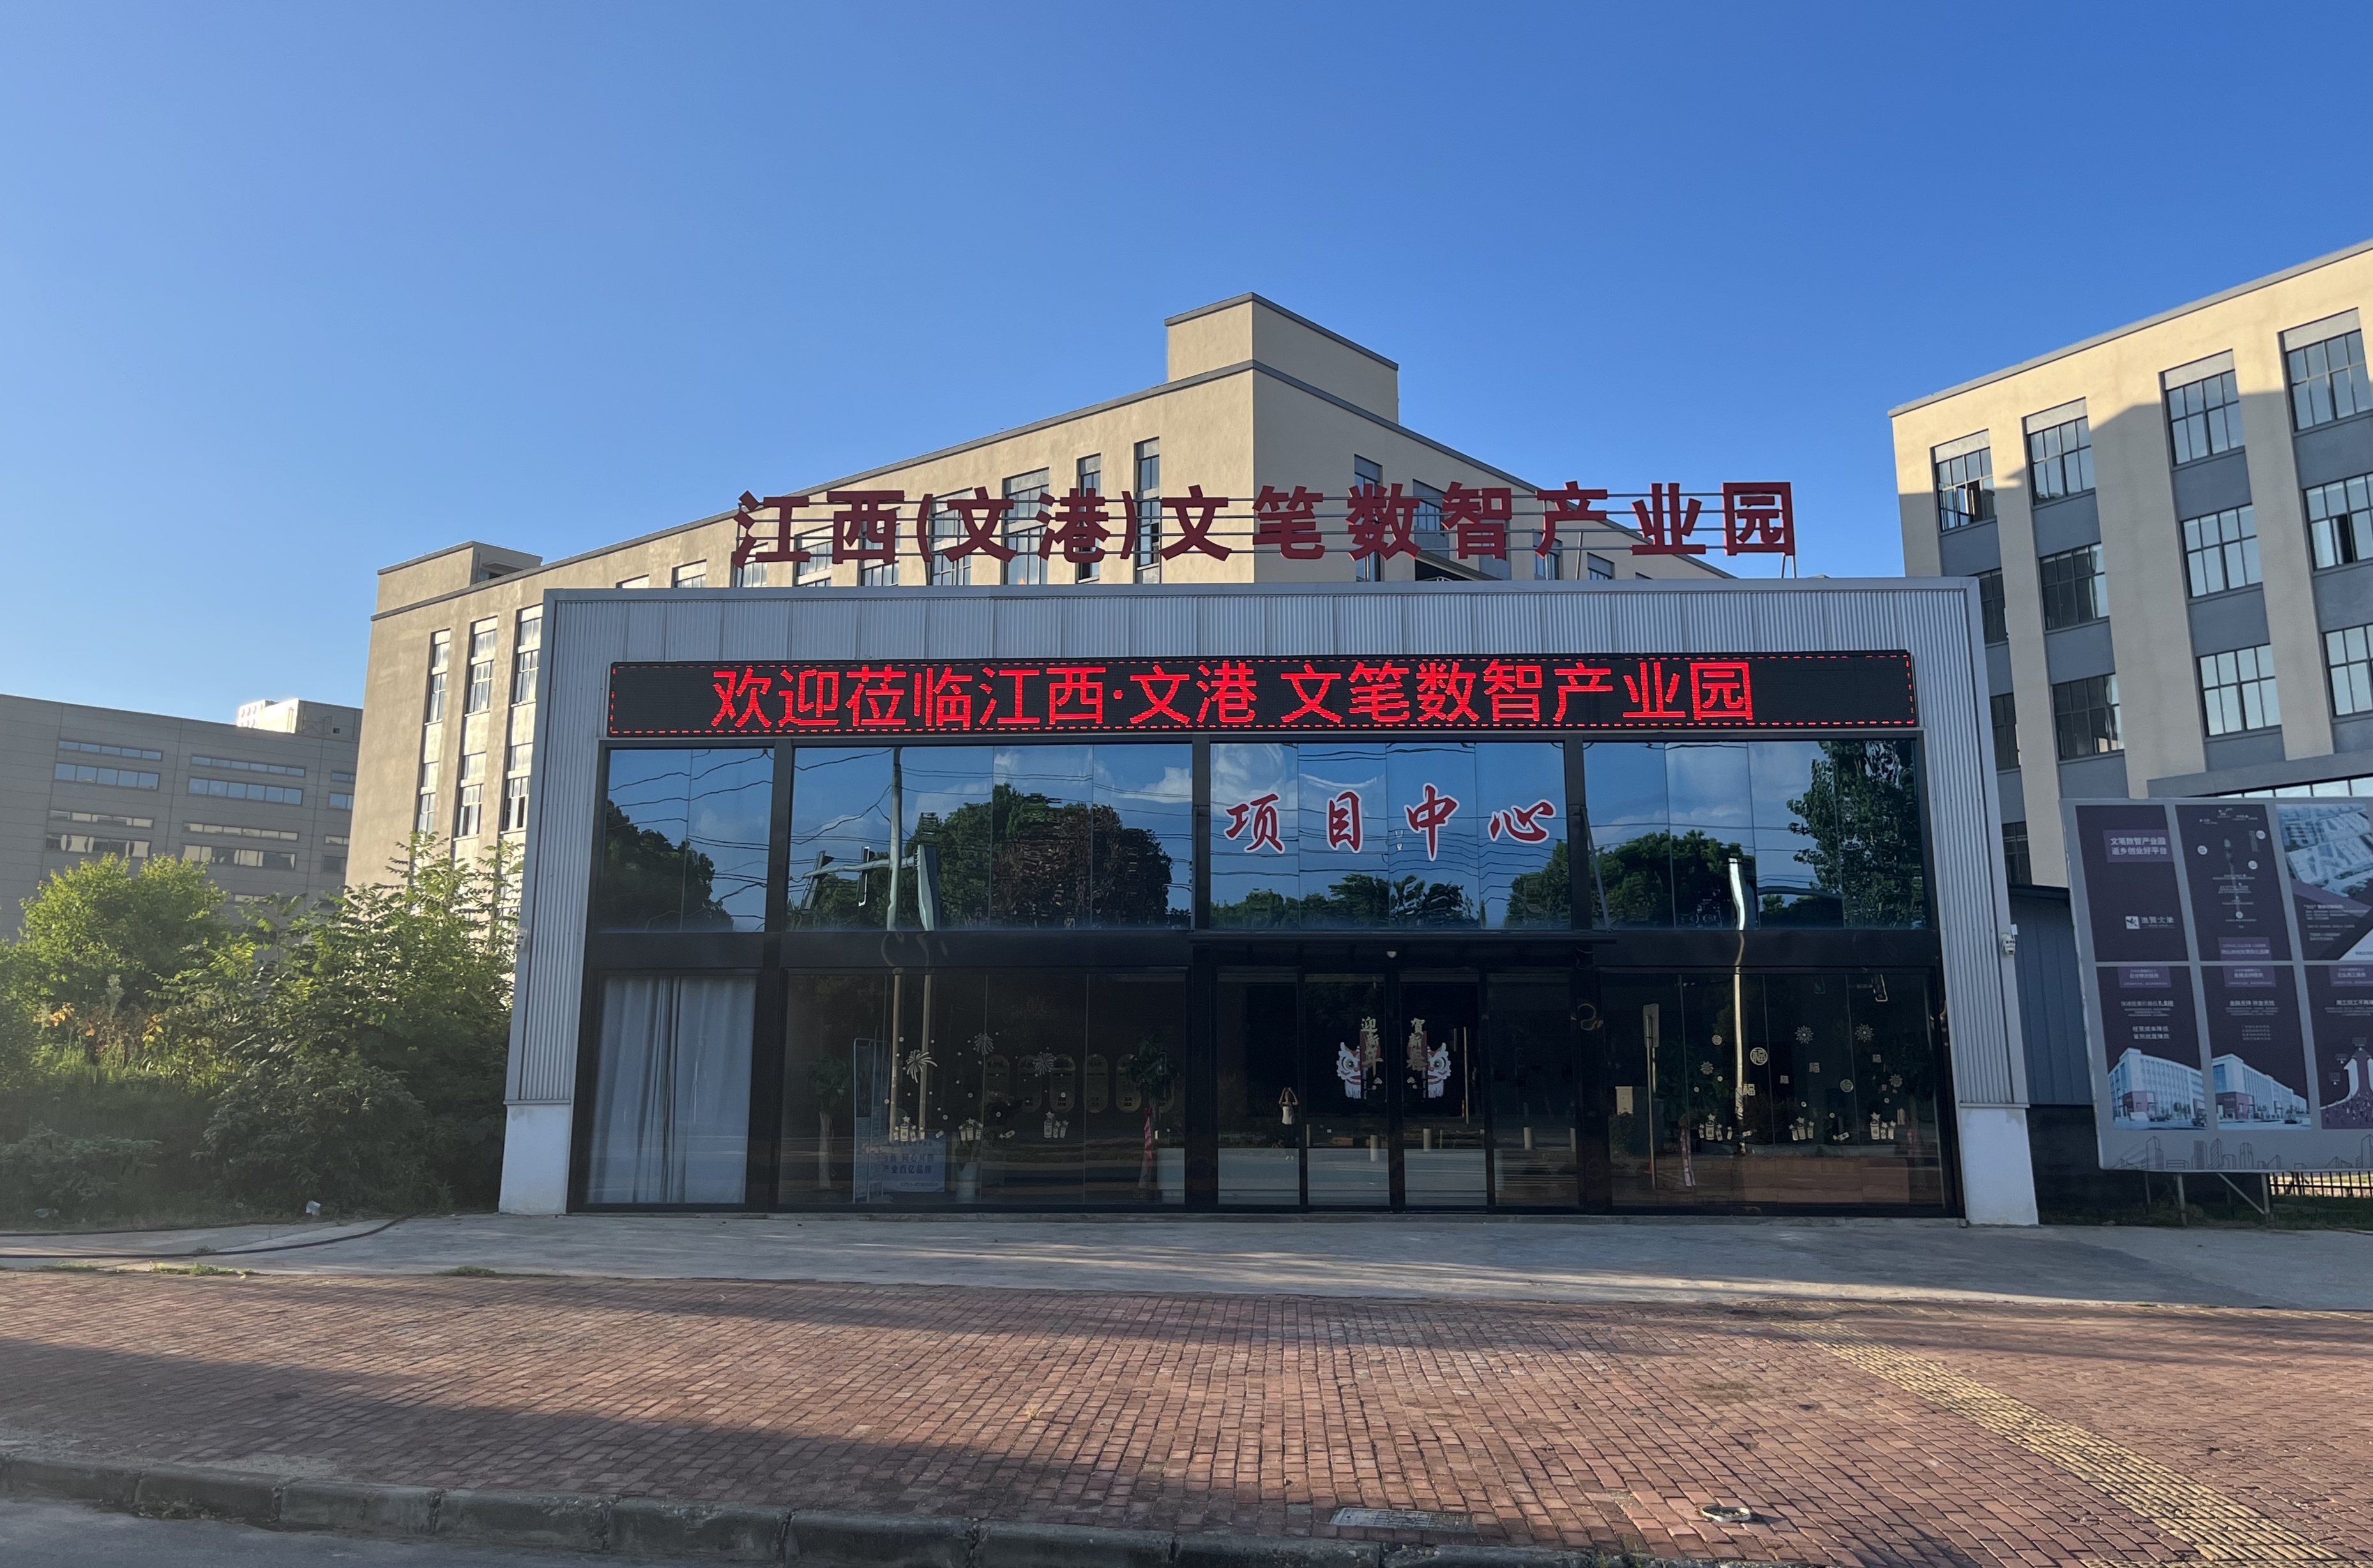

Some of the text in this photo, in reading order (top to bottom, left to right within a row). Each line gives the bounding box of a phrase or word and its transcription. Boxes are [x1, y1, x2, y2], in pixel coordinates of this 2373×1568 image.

[733, 481, 1795, 568] 江西(文港)文笔数智产业园
[1280, 660, 1754, 723] 文笔数智产业园
[1224, 782, 1557, 862] 项目中心
[1360, 1016, 1384, 1077] 迎新年
[1406, 1017, 1429, 1072] 贺新春
[1751, 1048, 1767, 1064] 福
[1743, 1083, 1756, 1096] 福
